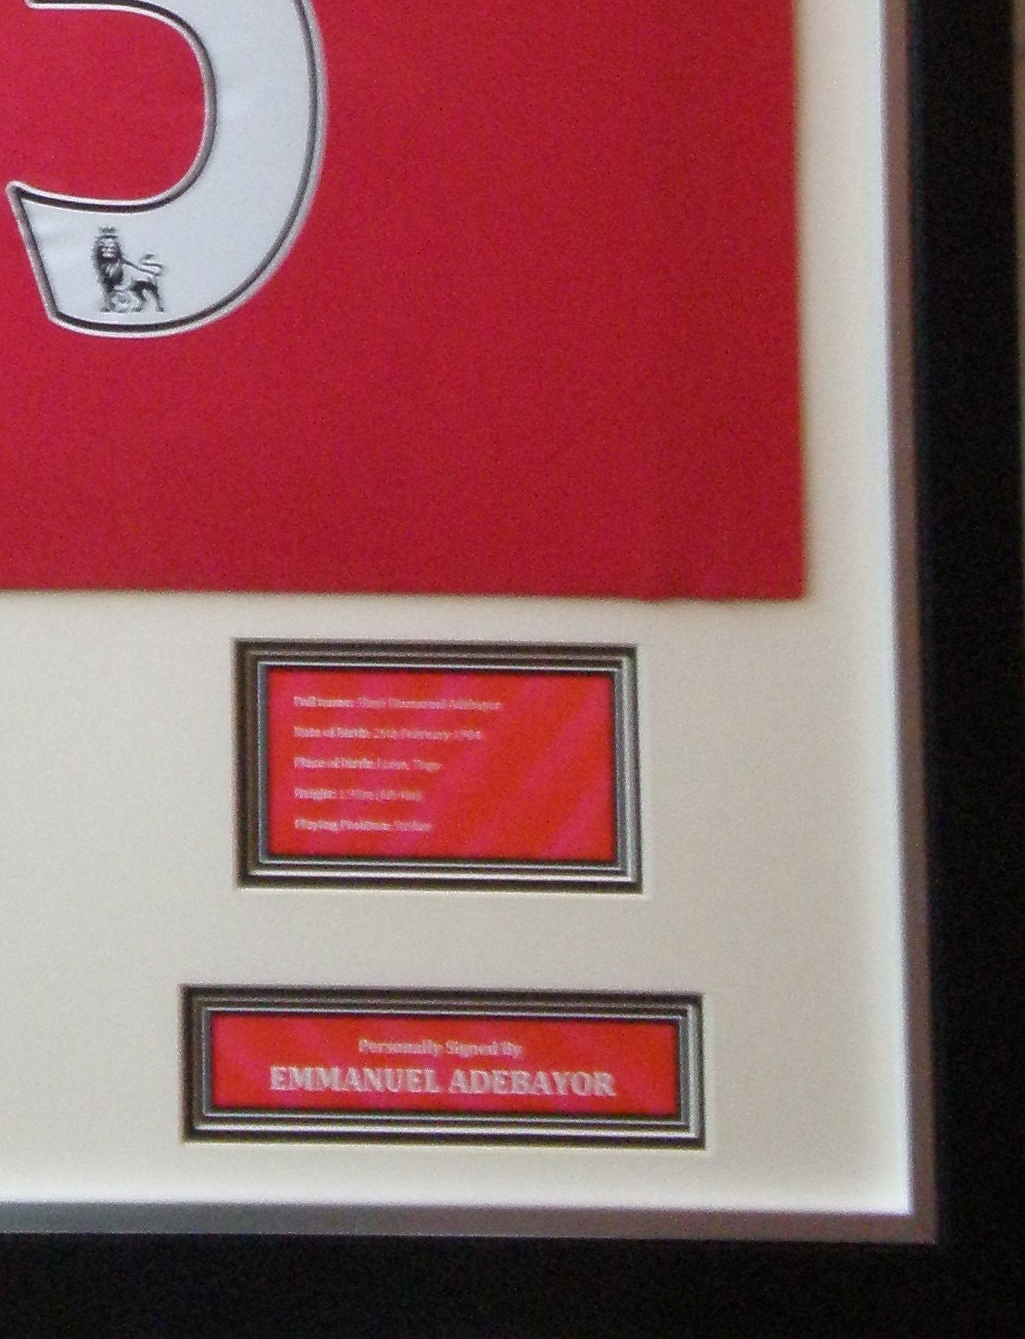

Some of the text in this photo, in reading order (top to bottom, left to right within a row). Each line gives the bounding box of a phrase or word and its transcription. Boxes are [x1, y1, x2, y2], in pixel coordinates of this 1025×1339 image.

[359, 1039, 525, 1059] Personally Signed By
[270, 1065, 617, 1097] EMMANUEL ADEBAYOR
